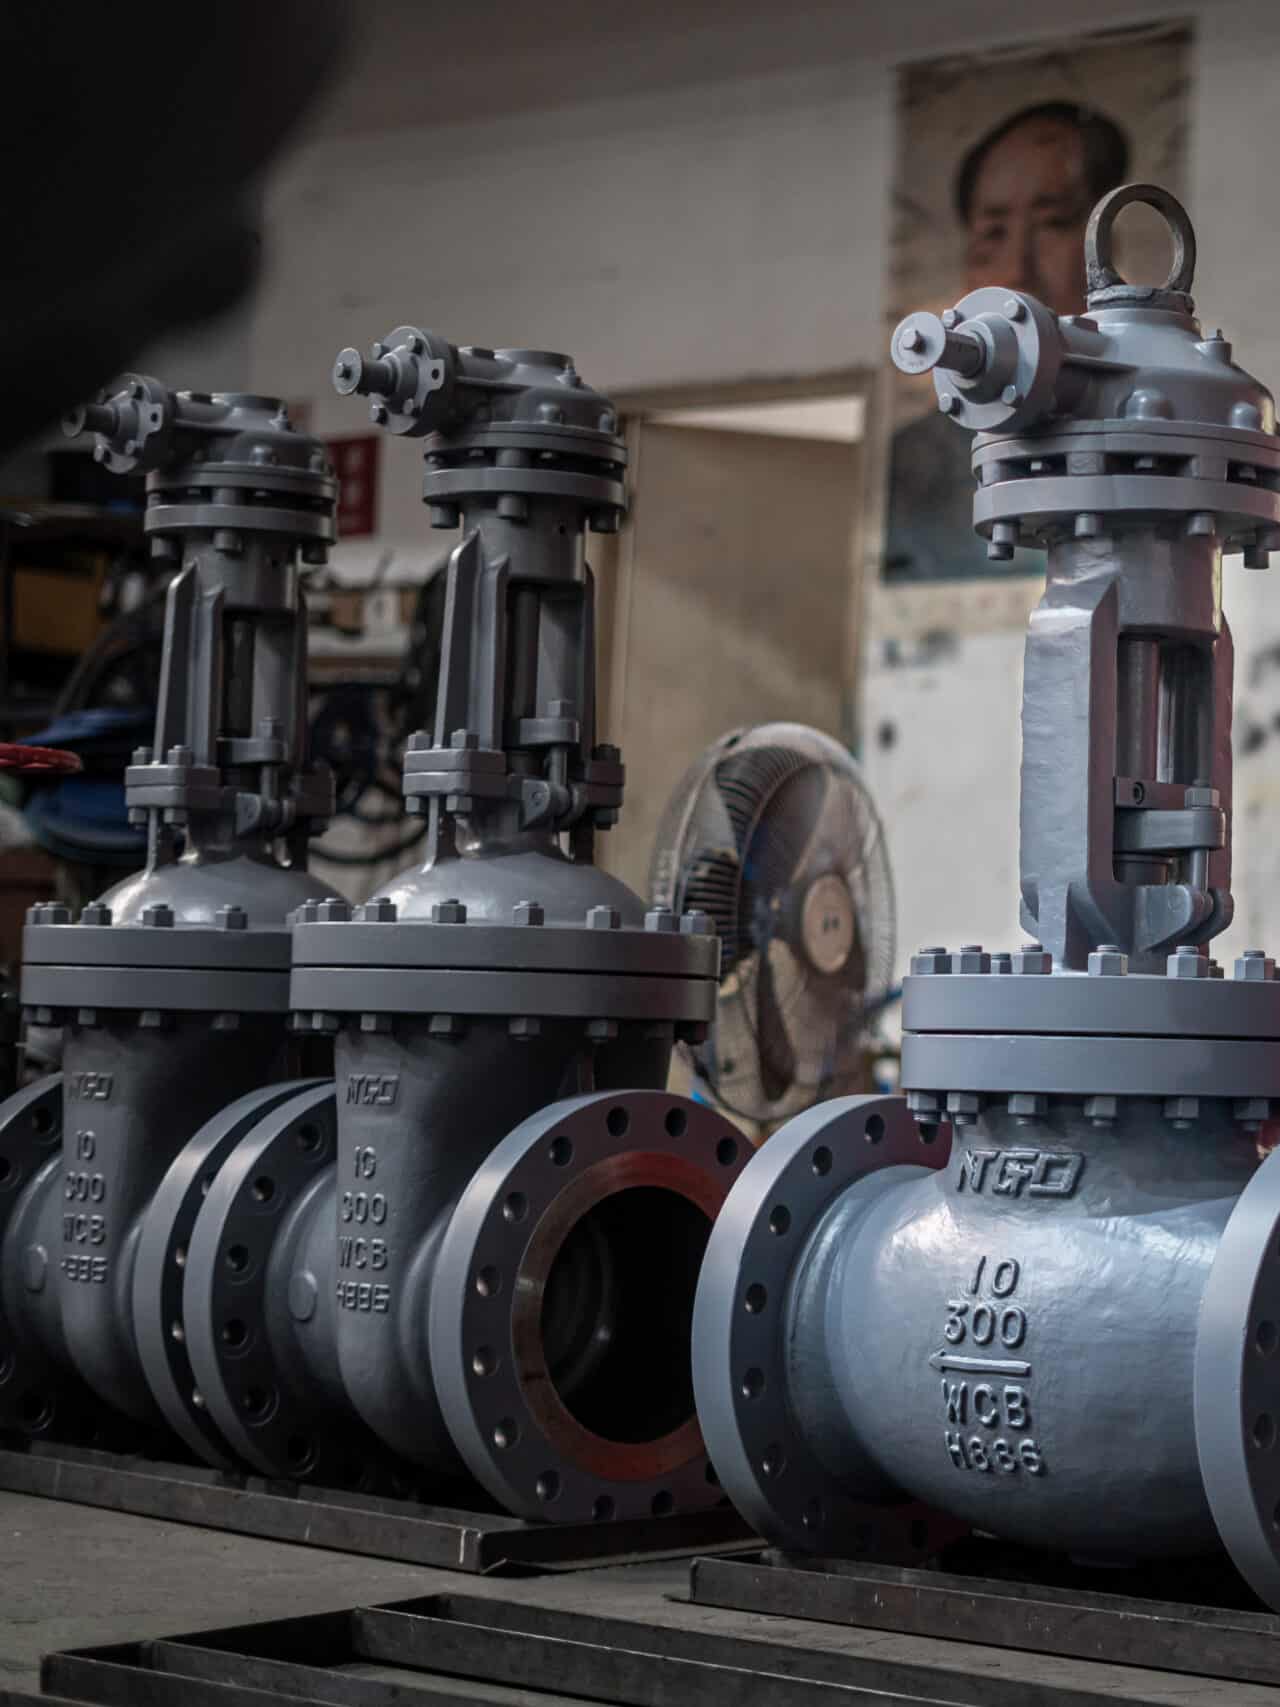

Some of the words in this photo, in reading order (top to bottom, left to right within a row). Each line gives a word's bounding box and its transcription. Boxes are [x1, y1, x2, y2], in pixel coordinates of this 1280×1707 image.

[76, 1130, 97, 1160] 10
[342, 1191, 388, 1225] 300
[339, 1236, 389, 1270] WCB
[969, 1255, 1021, 1298] 10
[943, 1300, 1028, 1349] 300
[941, 1378, 1032, 1429] WCB
